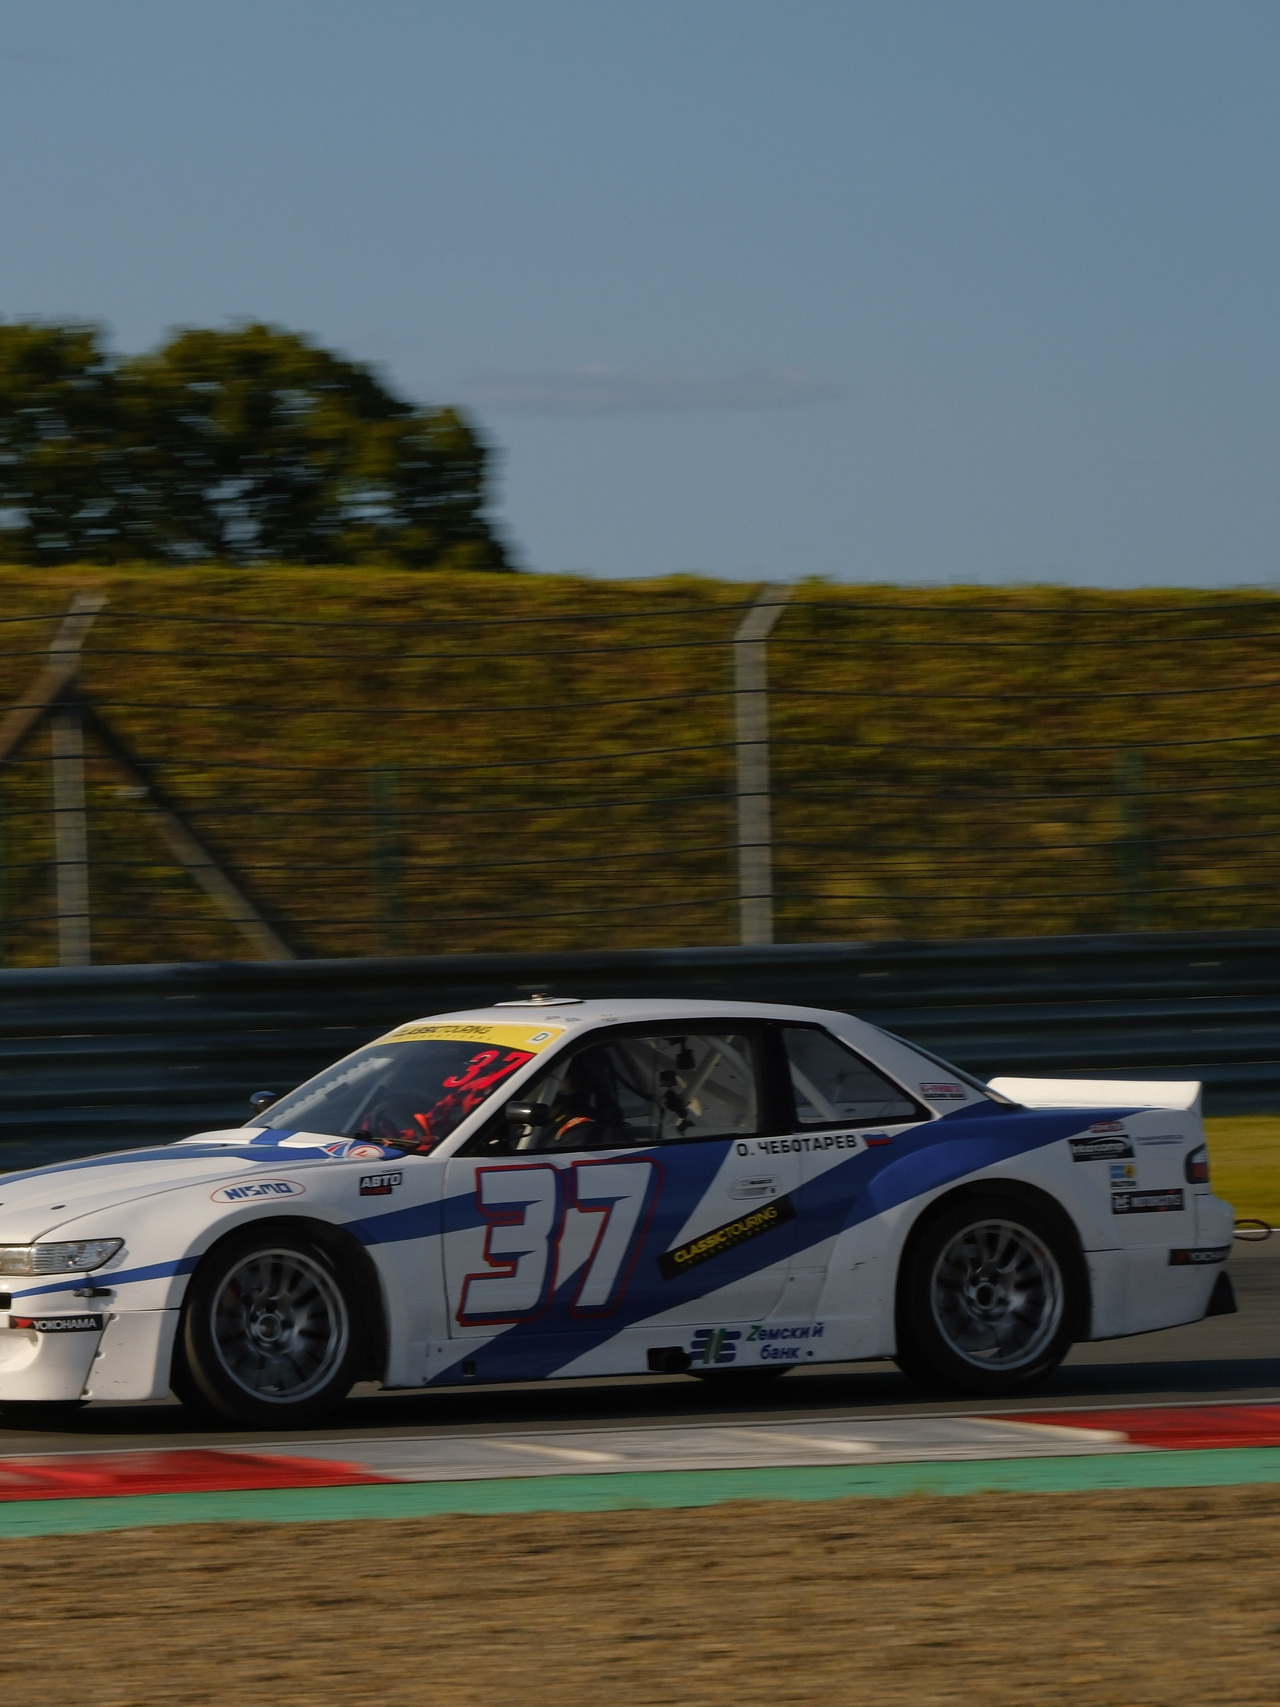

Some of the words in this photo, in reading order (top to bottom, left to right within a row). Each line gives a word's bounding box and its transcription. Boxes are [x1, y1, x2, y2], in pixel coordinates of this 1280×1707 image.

[442, 1050, 536, 1091] 37
[758, 1134, 857, 1155] ЧЕБОТАРЕВ
[361, 1173, 401, 1189] АВТО
[223, 1182, 294, 1201] NISMO
[456, 1156, 665, 1328] 37
[33, 1318, 97, 1330] YOKOHAMA
[760, 1344, 801, 1360] банк
